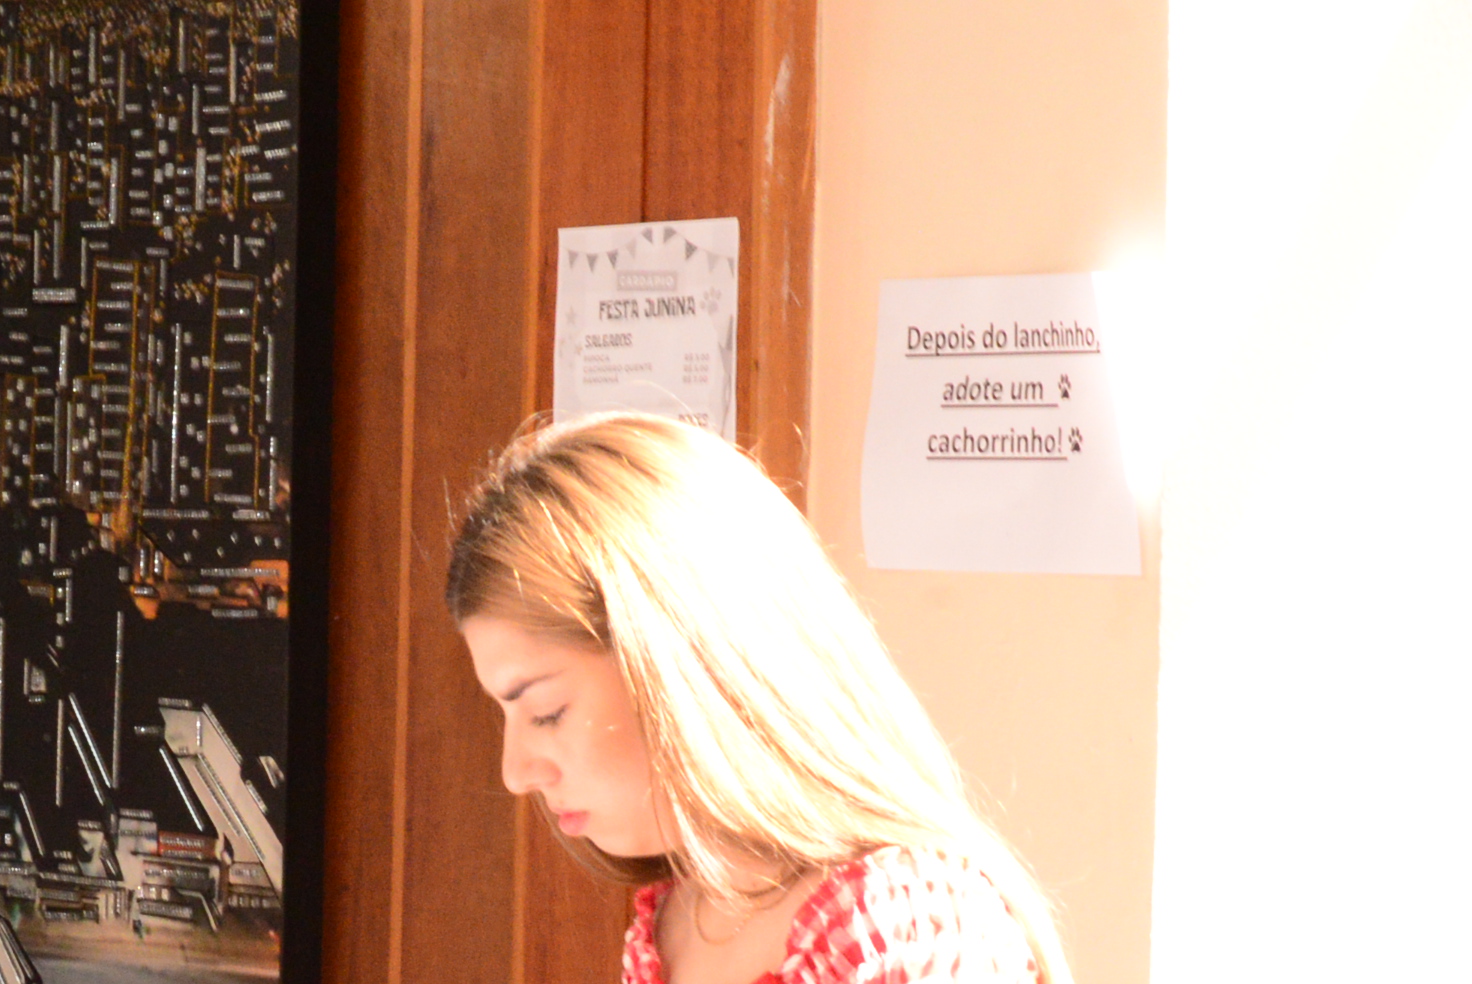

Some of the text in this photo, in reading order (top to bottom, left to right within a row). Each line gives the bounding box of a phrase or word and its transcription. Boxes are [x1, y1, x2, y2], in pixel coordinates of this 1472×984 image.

[599, 296, 697, 322] FESTA JUNINA
[585, 333, 633, 349] SALGADOS
[907, 321, 1101, 357] Depois do lanchinho,
[943, 375, 1044, 401] adote um
[928, 427, 1063, 454] cachorrinho!
